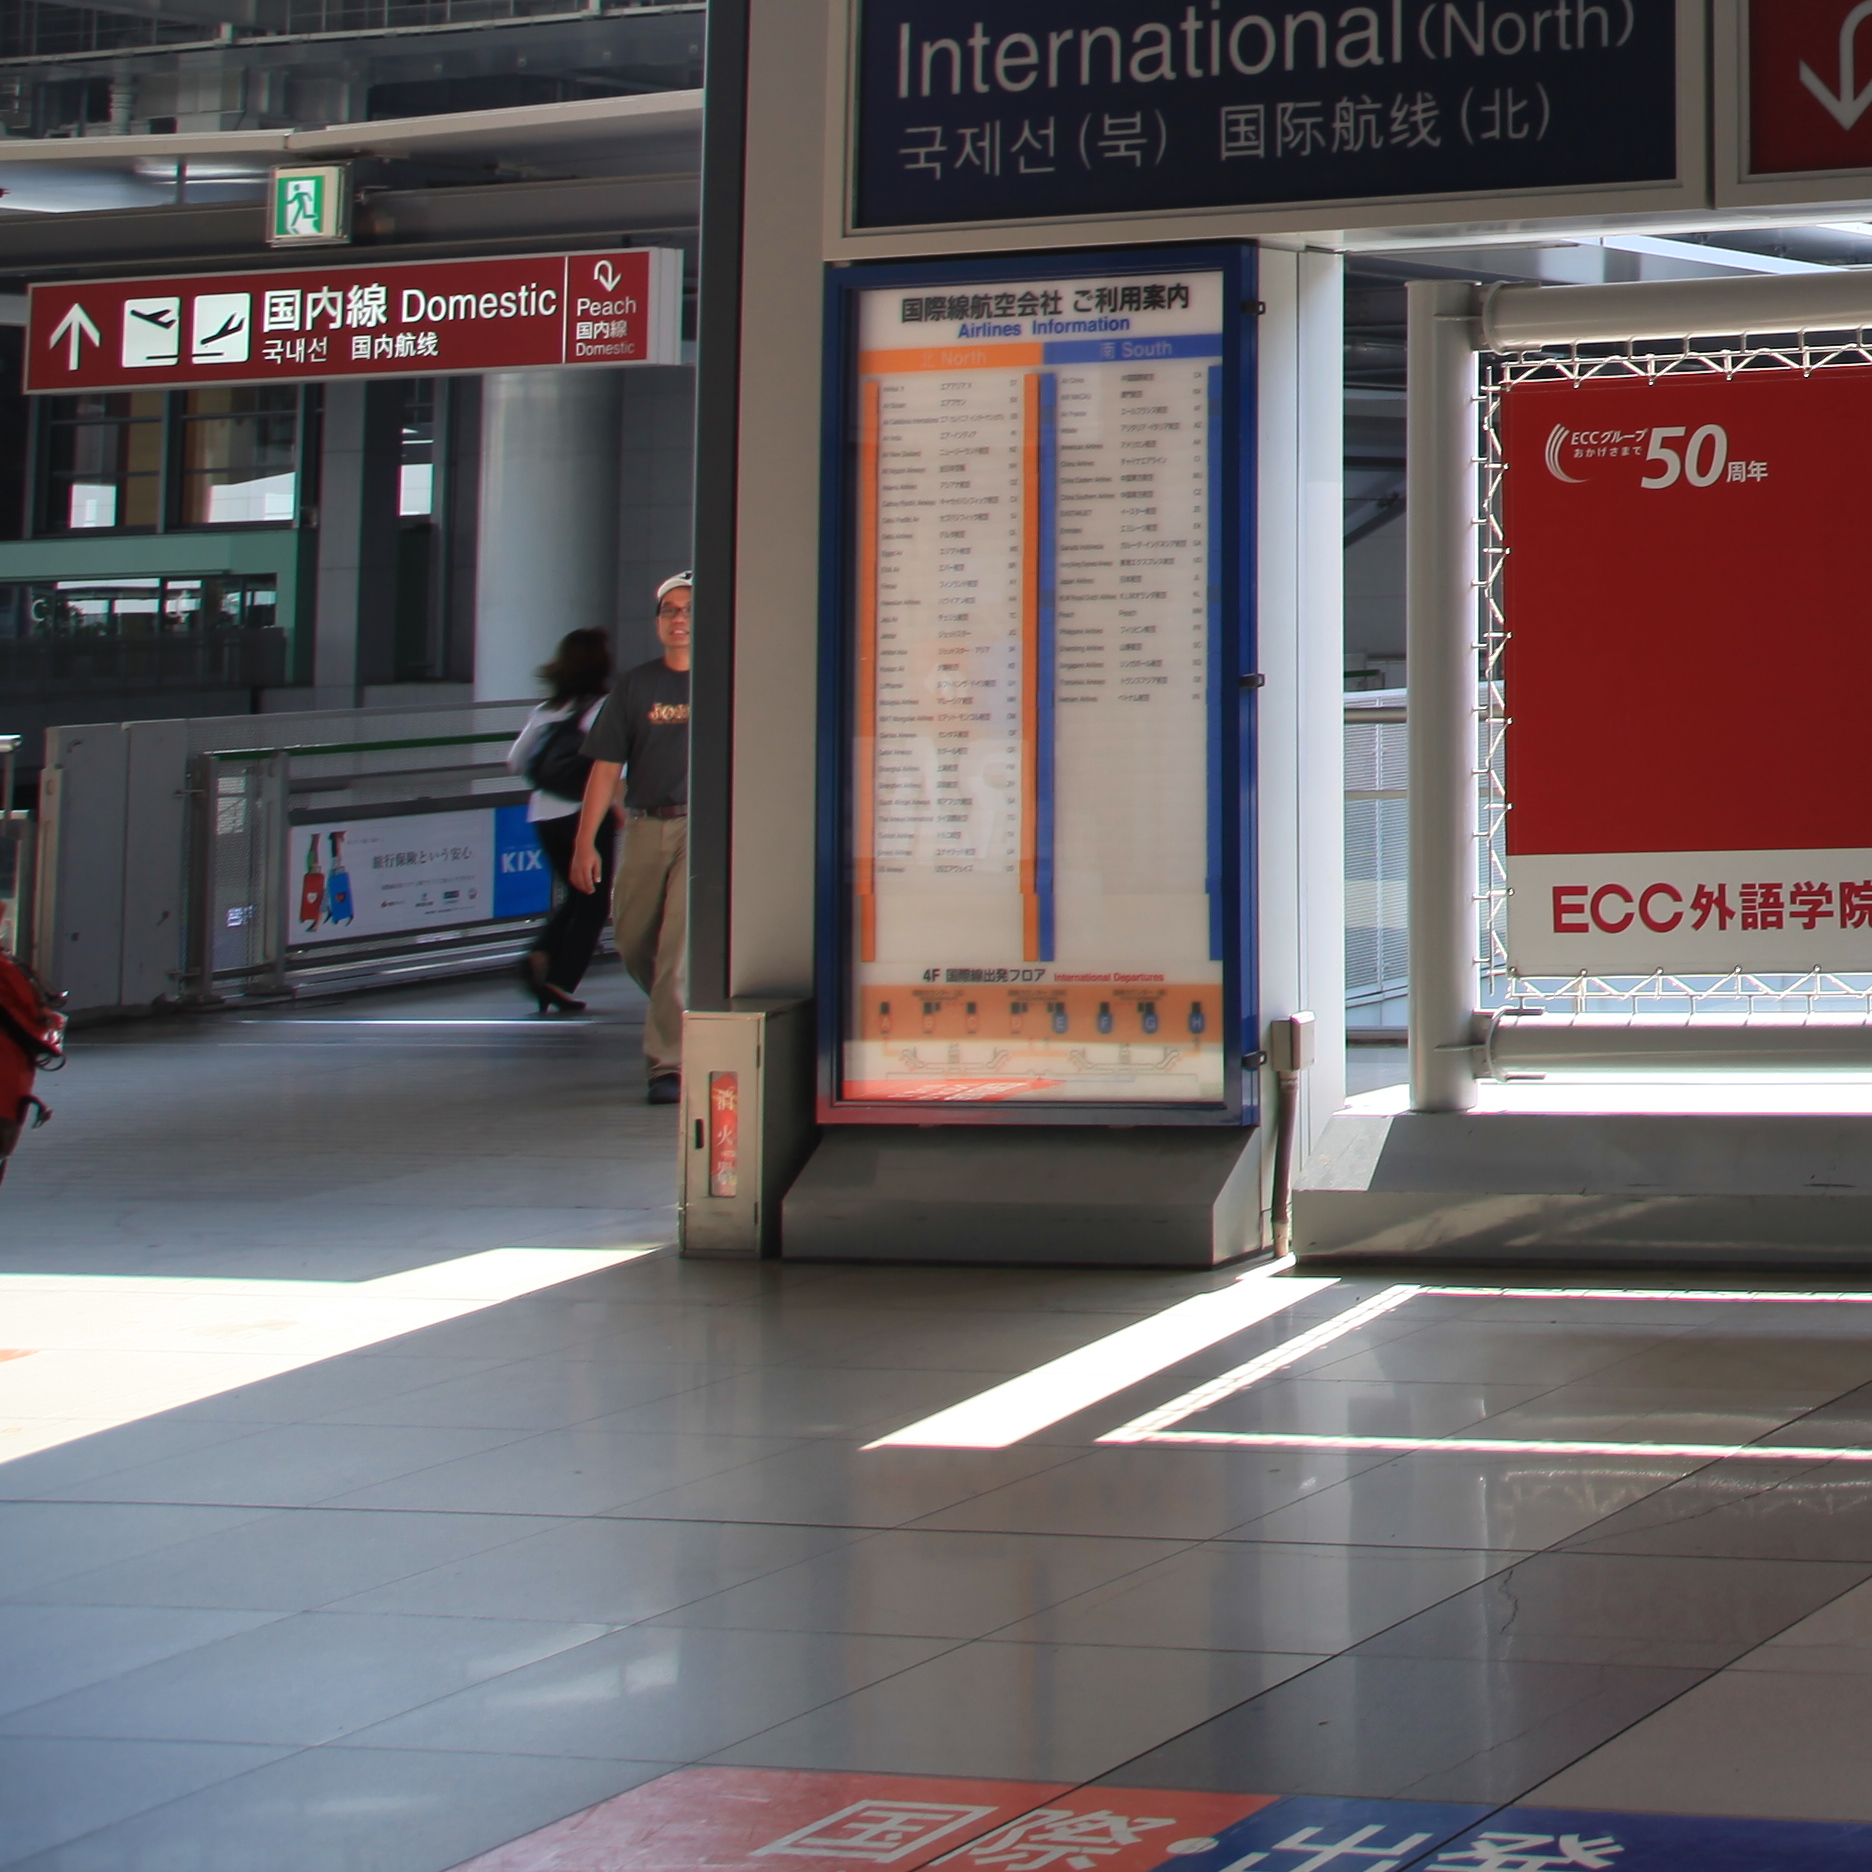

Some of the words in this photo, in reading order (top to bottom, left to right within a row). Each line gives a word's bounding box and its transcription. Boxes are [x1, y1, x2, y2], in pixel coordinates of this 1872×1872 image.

[262, 281, 387, 333] 国内線
[401, 282, 557, 324] Domestic
[577, 295, 637, 316] Peach
[901, 289, 1063, 323] 国際線航空会社
[1073, 283, 1190, 314] ご利用案内
[575, 319, 627, 340] 国内線
[958, 321, 1021, 339] Airlines
[1032, 316, 1130, 335] Information
[262, 336, 328, 364] 국내선
[351, 331, 439, 360] 国内航线
[576, 339, 636, 357] Domestic
[1121, 339, 1173, 359] South
[1570, 428, 1648, 446] ECCグループ
[1573, 445, 1643, 459] おかげさまで
[501, 848, 543, 874] KIX
[923, 968, 941, 983] 4F
[1054, 972, 1111, 983] International
